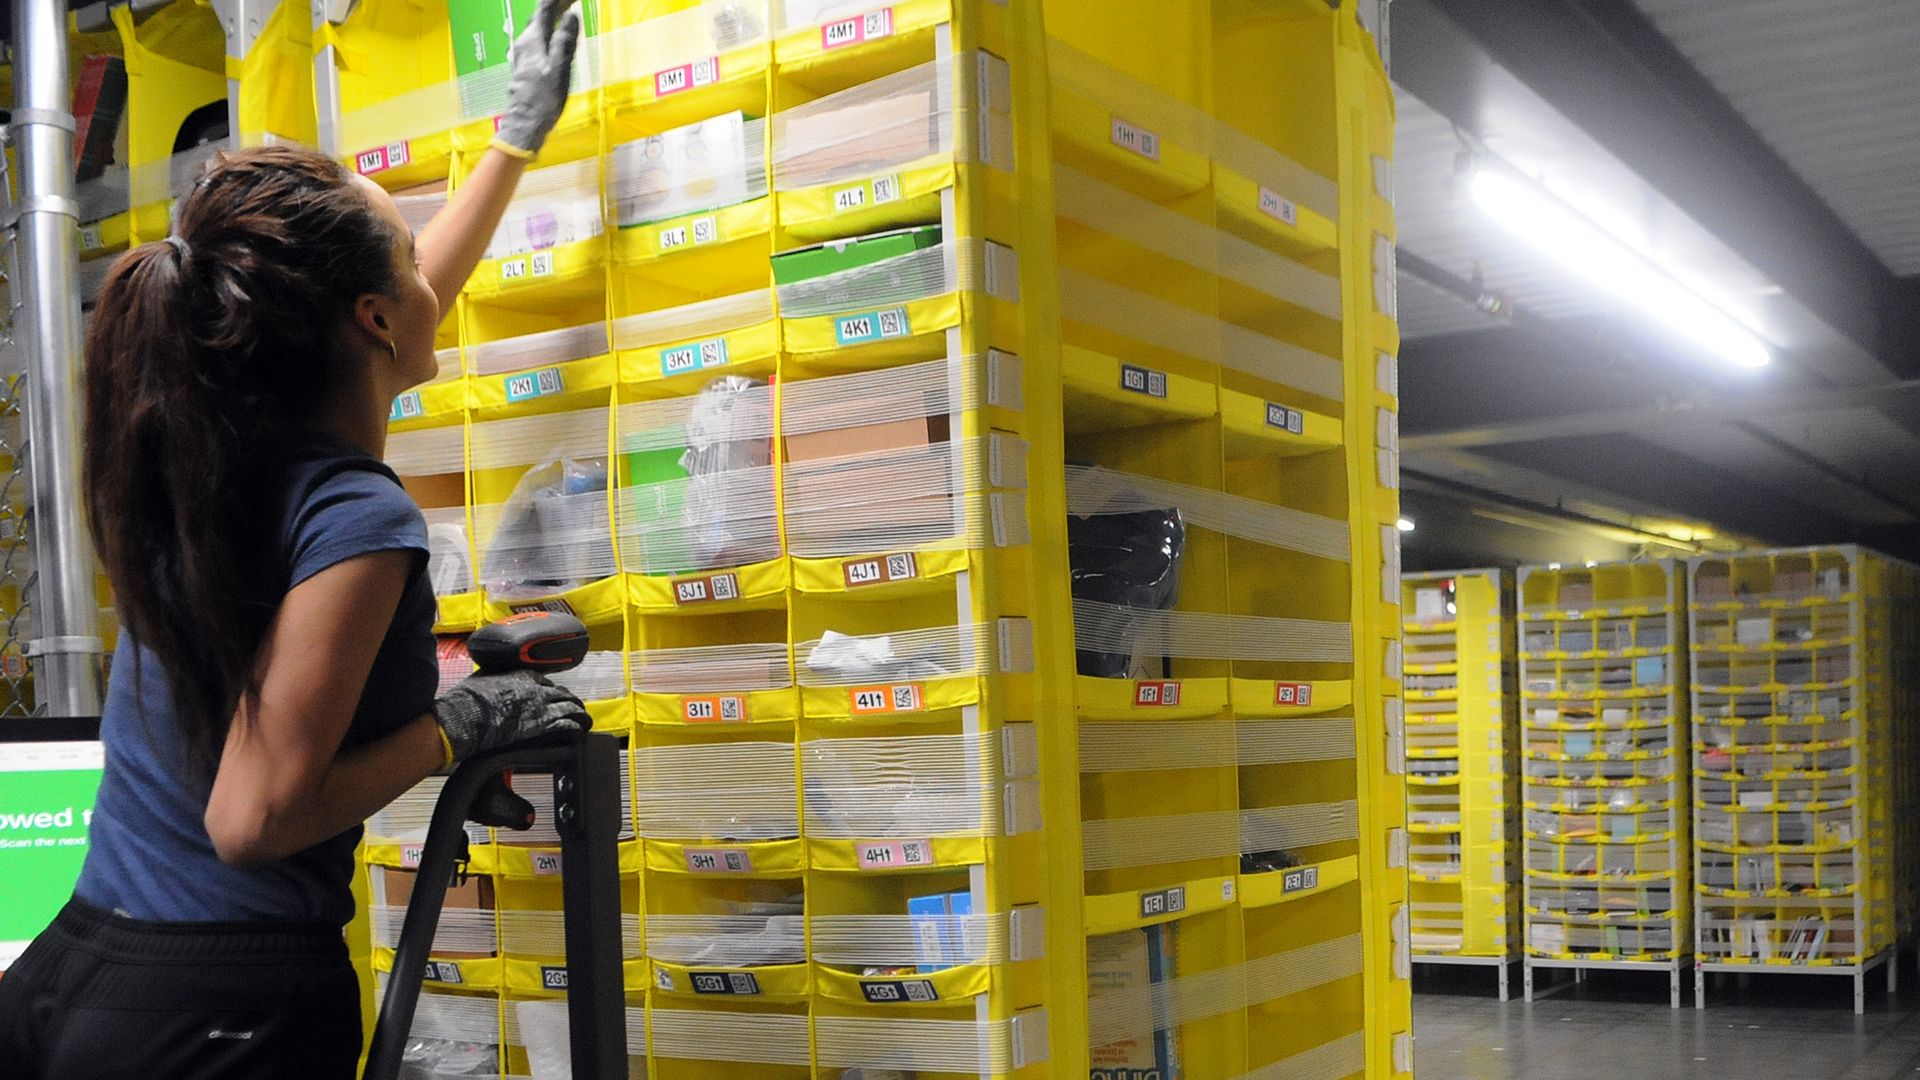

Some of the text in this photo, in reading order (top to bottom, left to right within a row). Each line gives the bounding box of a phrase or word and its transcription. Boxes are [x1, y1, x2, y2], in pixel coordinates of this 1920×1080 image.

[829, 22, 847, 40] 4M
[660, 73, 676, 88] 3M
[1117, 125, 1130, 143] 1H
[363, 153, 375, 169] 1M
[839, 192, 857, 208] 4L
[663, 228, 679, 245] 3L
[505, 262, 519, 277] 2L
[844, 321, 863, 336] 4K
[668, 352, 687, 367] 3K
[1127, 370, 1140, 387] 1G
[512, 379, 527, 394] 2K
[851, 564, 868, 579] 4J
[680, 583, 697, 598] 3J
[857, 693, 874, 707] 4I
[1141, 687, 1153, 701] 1F
[688, 703, 703, 717] 3I
[537, 857, 551, 869] 2H
[692, 855, 710, 867] 3H
[866, 849, 884, 863] 4H
[1287, 875, 1298, 889] 2E
[1145, 896, 1159, 912] 1E
[547, 972, 562, 984] 2G
[697, 977, 716, 990] 3G
[869, 986, 890, 998] 4G
